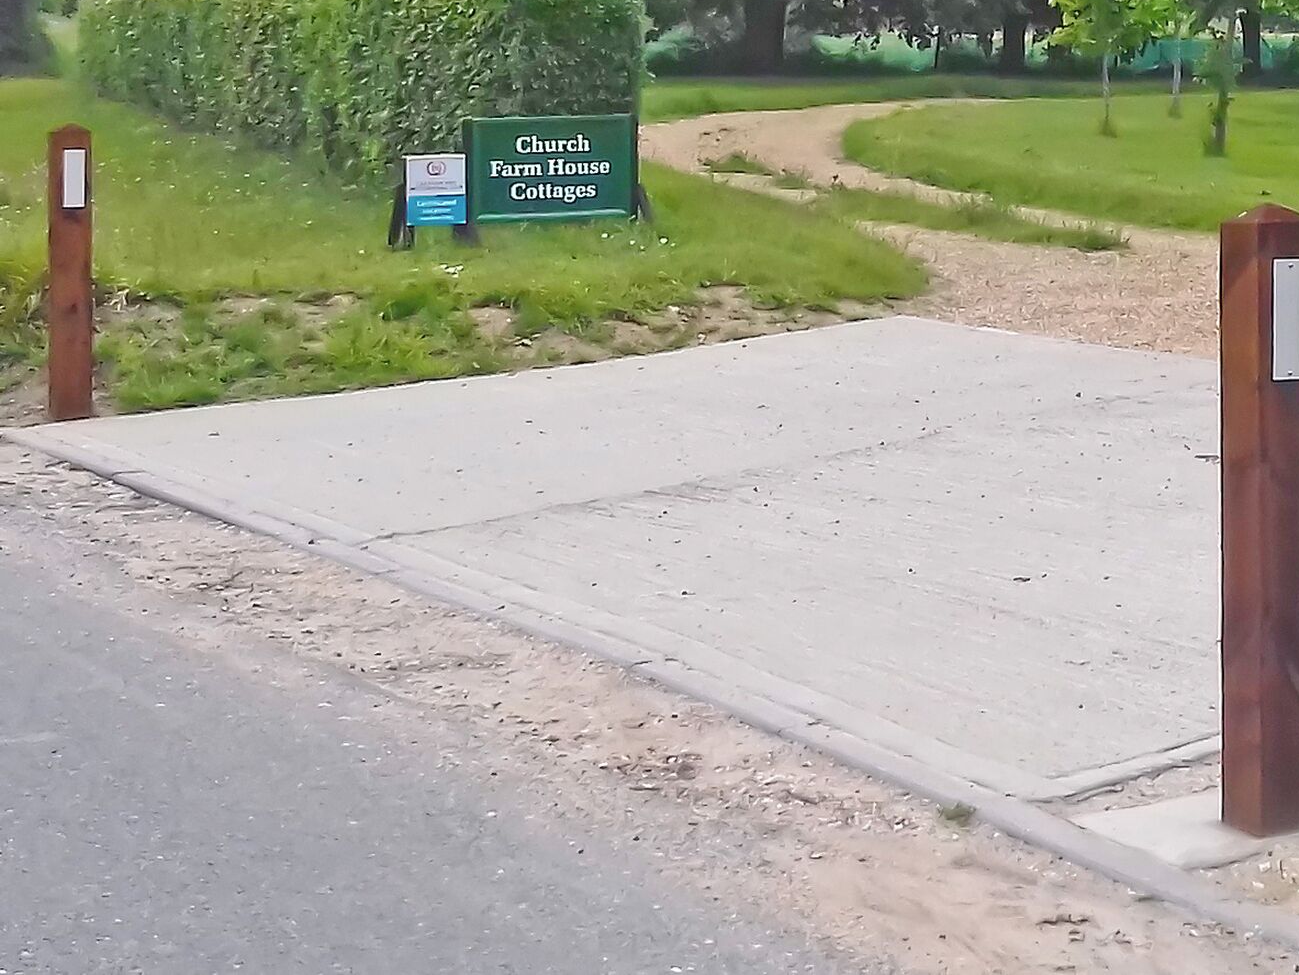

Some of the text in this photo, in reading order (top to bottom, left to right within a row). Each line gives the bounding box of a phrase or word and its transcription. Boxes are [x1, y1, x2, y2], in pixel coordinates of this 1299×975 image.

[516, 134, 590, 153] Church
[489, 158, 610, 177] Farm House
[510, 183, 596, 203] Cottages
